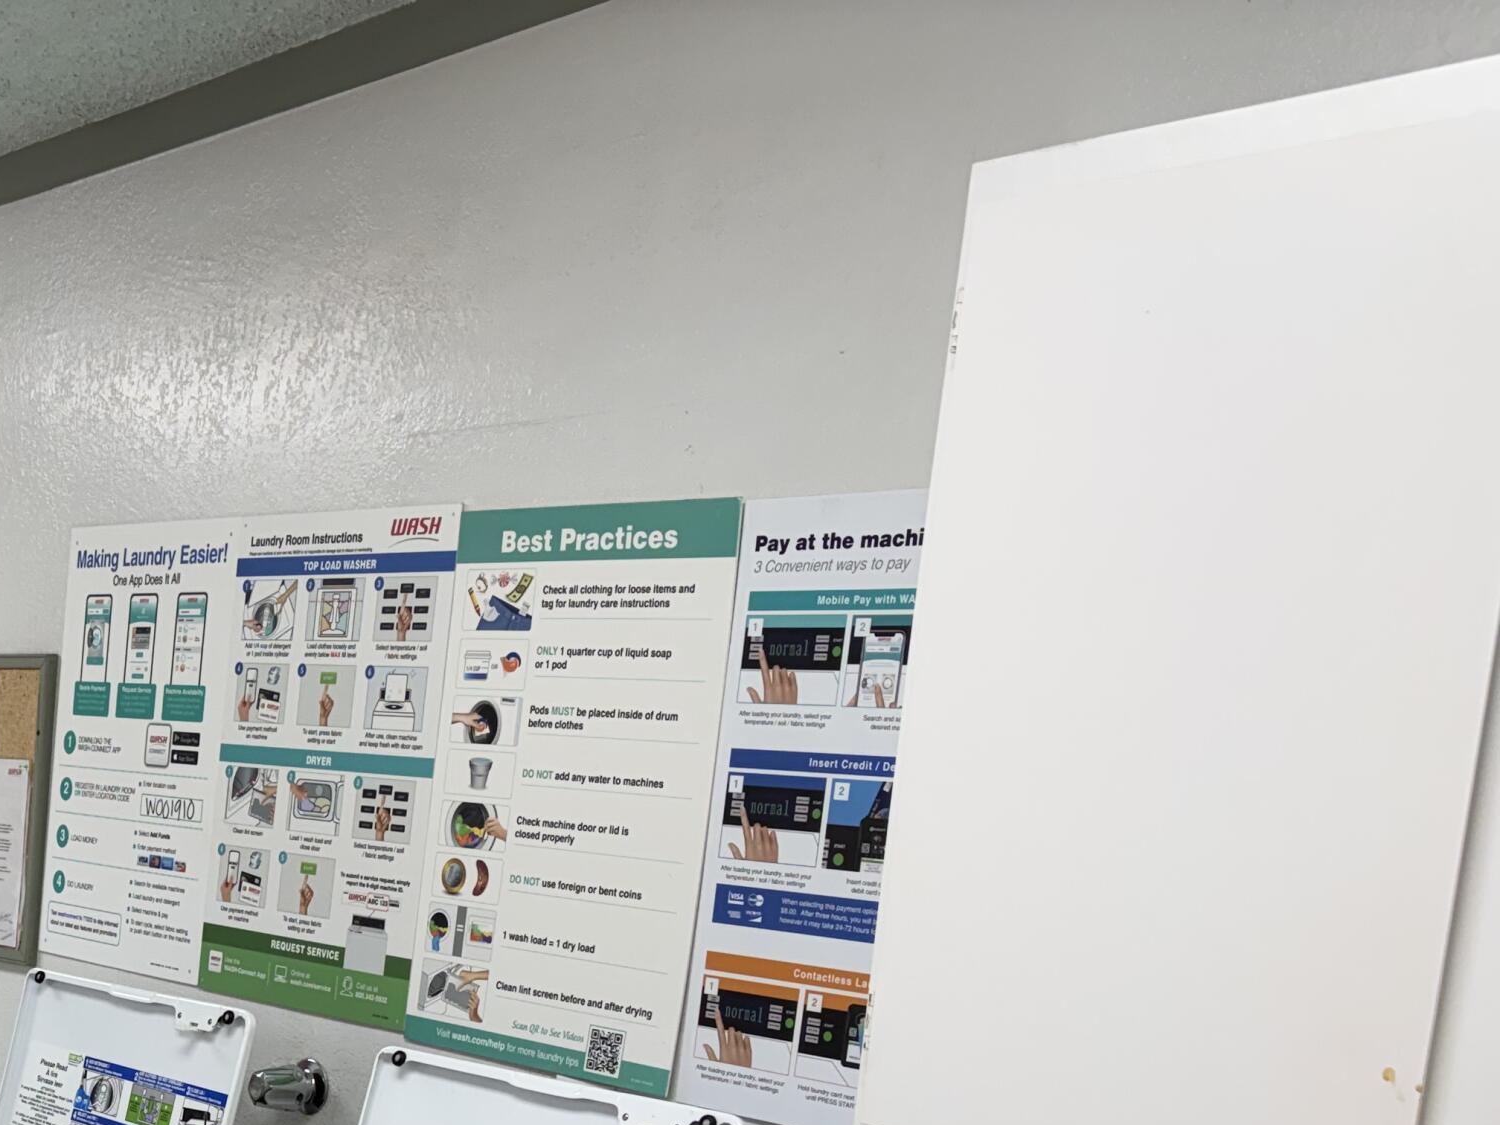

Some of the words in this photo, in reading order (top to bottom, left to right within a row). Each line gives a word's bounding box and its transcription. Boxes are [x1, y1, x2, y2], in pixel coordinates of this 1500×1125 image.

[390, 516, 442, 536] WASH
[250, 535, 284, 549] Laundry
[284, 534, 310, 546] Room
[311, 531, 363, 544] Instructions
[501, 529, 553, 553] Best
[559, 525, 678, 551] Practices
[754, 535, 790, 555] Pay
[795, 533, 816, 551] at
[821, 532, 854, 550] the
[860, 527, 925, 548] machi
[76, 548, 119, 571] Making
[122, 545, 177, 569] Laundry
[179, 542, 228, 565] Easier!
[303, 560, 319, 571] TOP
[319, 560, 342, 571] LOAD
[343, 558, 377, 570] WASHER
[753, 560, 763, 574] 3
[764, 559, 834, 573] Convenient
[836, 559, 868, 574] ways
[870, 557, 884, 570] to
[885, 558, 912, 573] pay
[112, 574, 128, 587] One
[128, 574, 143, 588] App
[144, 573, 163, 586] Does
[164, 573, 170, 585] It
[170, 572, 181, 584] All
[542, 584, 567, 595] Check
[568, 584, 579, 595] all
[579, 584, 613, 597] clothing
[614, 584, 627, 594] for
[627, 584, 652, 594] loose
[652, 583, 677, 594] items
[678, 583, 696, 594] and
[541, 599, 554, 610] tag
[555, 598, 567, 608] for
[567, 598, 599, 610] laundry
[599, 599, 618, 608] care
[619, 598, 670, 608] instructions
[816, 595, 850, 605] Mobile
[853, 594, 872, 607] Pay
[874, 594, 896, 604] with
[899, 594, 915, 604] WA
[536, 646, 558, 655] ONLY
[560, 646, 564, 656] 1
[566, 647, 596, 658] quarter
[596, 648, 613, 659] cup
[614, 647, 624, 657] of
[624, 647, 649, 660] liquid
[650, 649, 672, 660] soap
[768, 640, 809, 656] normal
[534, 660, 544, 669] or
[545, 659, 550, 669] 1
[551, 659, 568, 671] pod
[529, 704, 549, 715] Pods
[551, 706, 575, 716] MUST
[576, 707, 587, 717] be
[587, 707, 616, 719] placed
[617, 709, 643, 720] inside
[644, 710, 654, 720] of
[655, 710, 679, 721] drum
[527, 718, 553, 729] before
[554, 719, 584, 730] clothes
[305, 755, 332, 766] DRYER
[808, 757, 838, 769] Insert
[840, 758, 873, 771] Credit
[882, 762, 895, 772] De
[522, 768, 534, 778] DO
[536, 769, 553, 779] NOT
[554, 771, 570, 781] add
[571, 773, 587, 785] any
[587, 775, 611, 784] water
[612, 775, 621, 785] to
[622, 777, 664, 789] machines
[750, 800, 789, 816] normal
[516, 815, 541, 827] Check
[541, 819, 576, 830] machine
[576, 822, 597, 832] door
[597, 825, 608, 834] or
[608, 824, 620, 835] lid
[621, 825, 629, 836] is
[514, 829, 541, 840] closed
[541, 833, 575, 846] properly
[509, 874, 522, 884] DO
[523, 876, 540, 886] NOT
[541, 880, 556, 889] use
[557, 880, 586, 895] foreign
[587, 886, 597, 894] or
[598, 885, 617, 897] bent
[618, 889, 642, 900] coins
[270, 939, 306, 954] REQUEST
[306, 945, 340, 961] SERVICE
[502, 930, 507, 939] 1
[508, 933, 529, 943] wash
[529, 934, 548, 946] load
[556, 939, 560, 948] 1
[561, 940, 576, 953] dry
[577, 942, 596, 954] load
[793, 968, 852, 986] Contactless
[855, 977, 868, 988] La
[495, 980, 517, 993] Clean
[518, 984, 531, 995] lint
[532, 989, 559, 1001] screen
[559, 992, 586, 1006] before
[586, 999, 603, 1009] and
[603, 1001, 624, 1013] after
[624, 1005, 653, 1021] drying
[724, 1005, 763, 1023] normal
[511, 1020, 528, 1031] Scan
[528, 1023, 540, 1035] QR
[540, 1026, 548, 1035] to
[548, 1027, 561, 1038] See
[562, 1030, 584, 1043] Videos
[436, 1027, 451, 1038] Visit
[451, 1033, 505, 1050] wash.com/help
[506, 1042, 516, 1052] for
[517, 1046, 536, 1058] more
[536, 1049, 565, 1065] laundry
[565, 1055, 579, 1067] tips
